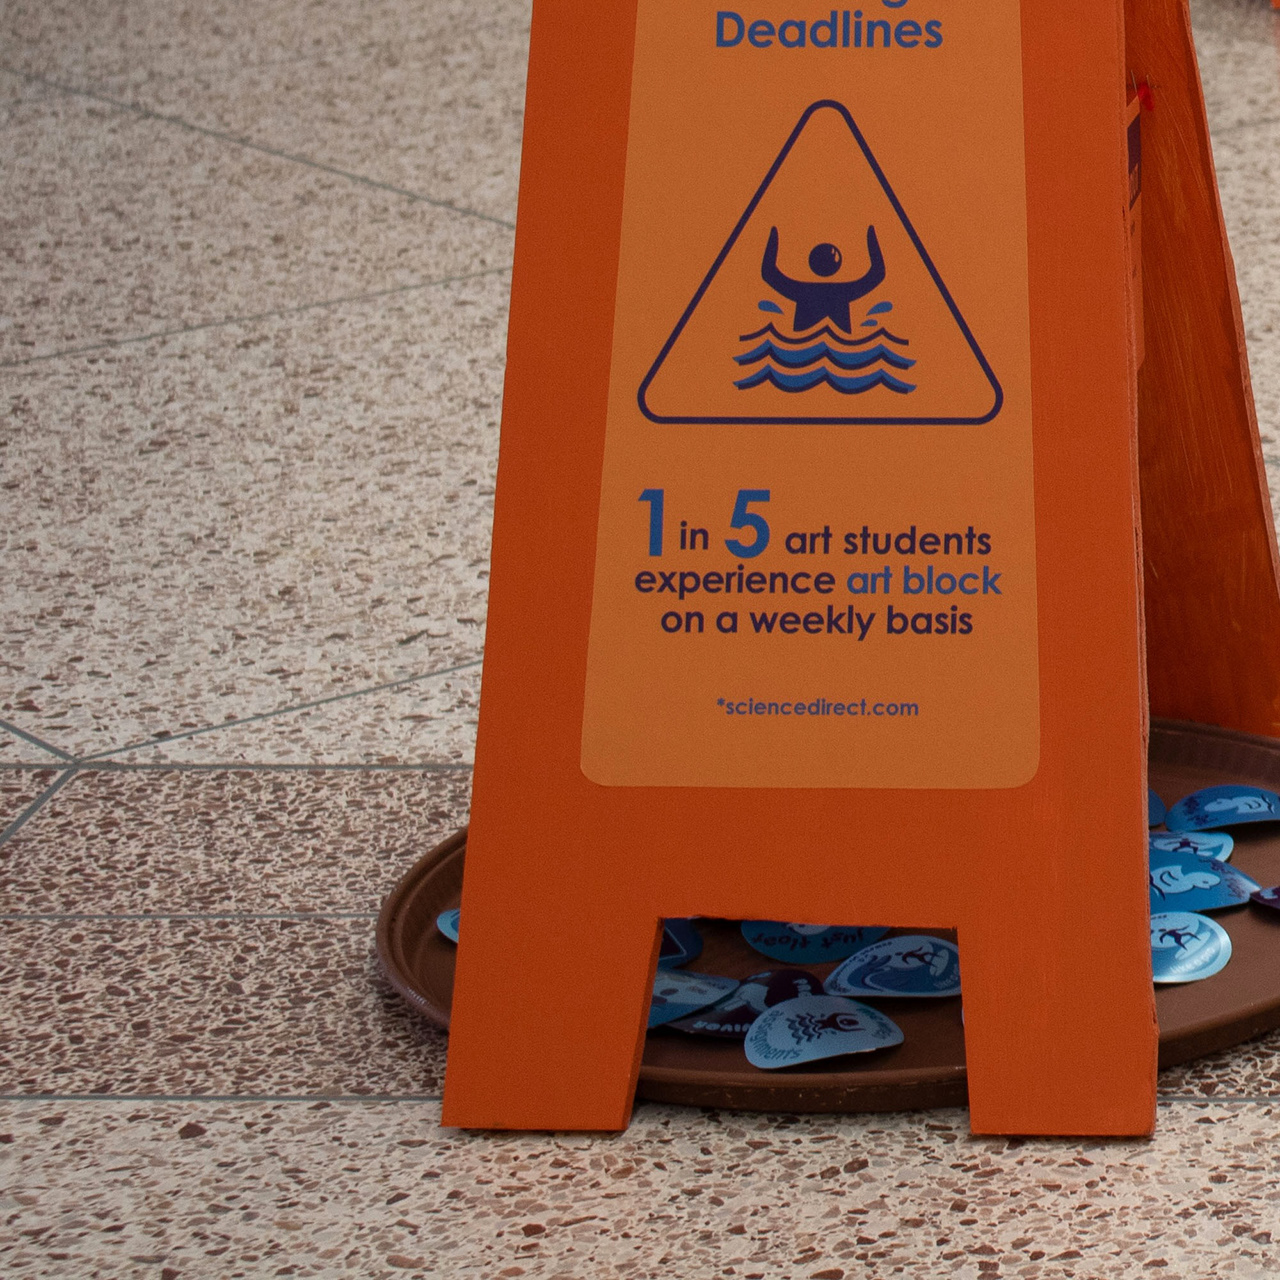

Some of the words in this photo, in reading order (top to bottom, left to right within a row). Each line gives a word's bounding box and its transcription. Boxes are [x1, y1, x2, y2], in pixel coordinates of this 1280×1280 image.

[715, 10, 944, 49] Deadlines
[638, 488, 665, 557] 1
[679, 520, 709, 550] in
[724, 489, 771, 559] 5
[785, 525, 833, 555] art
[843, 525, 992, 556] students
[634, 564, 836, 600] experience
[846, 565, 893, 595] art
[903, 565, 1002, 595] block
[661, 608, 704, 634] on
[716, 608, 738, 634] a
[749, 605, 876, 641] weekly
[886, 605, 973, 635] basis
